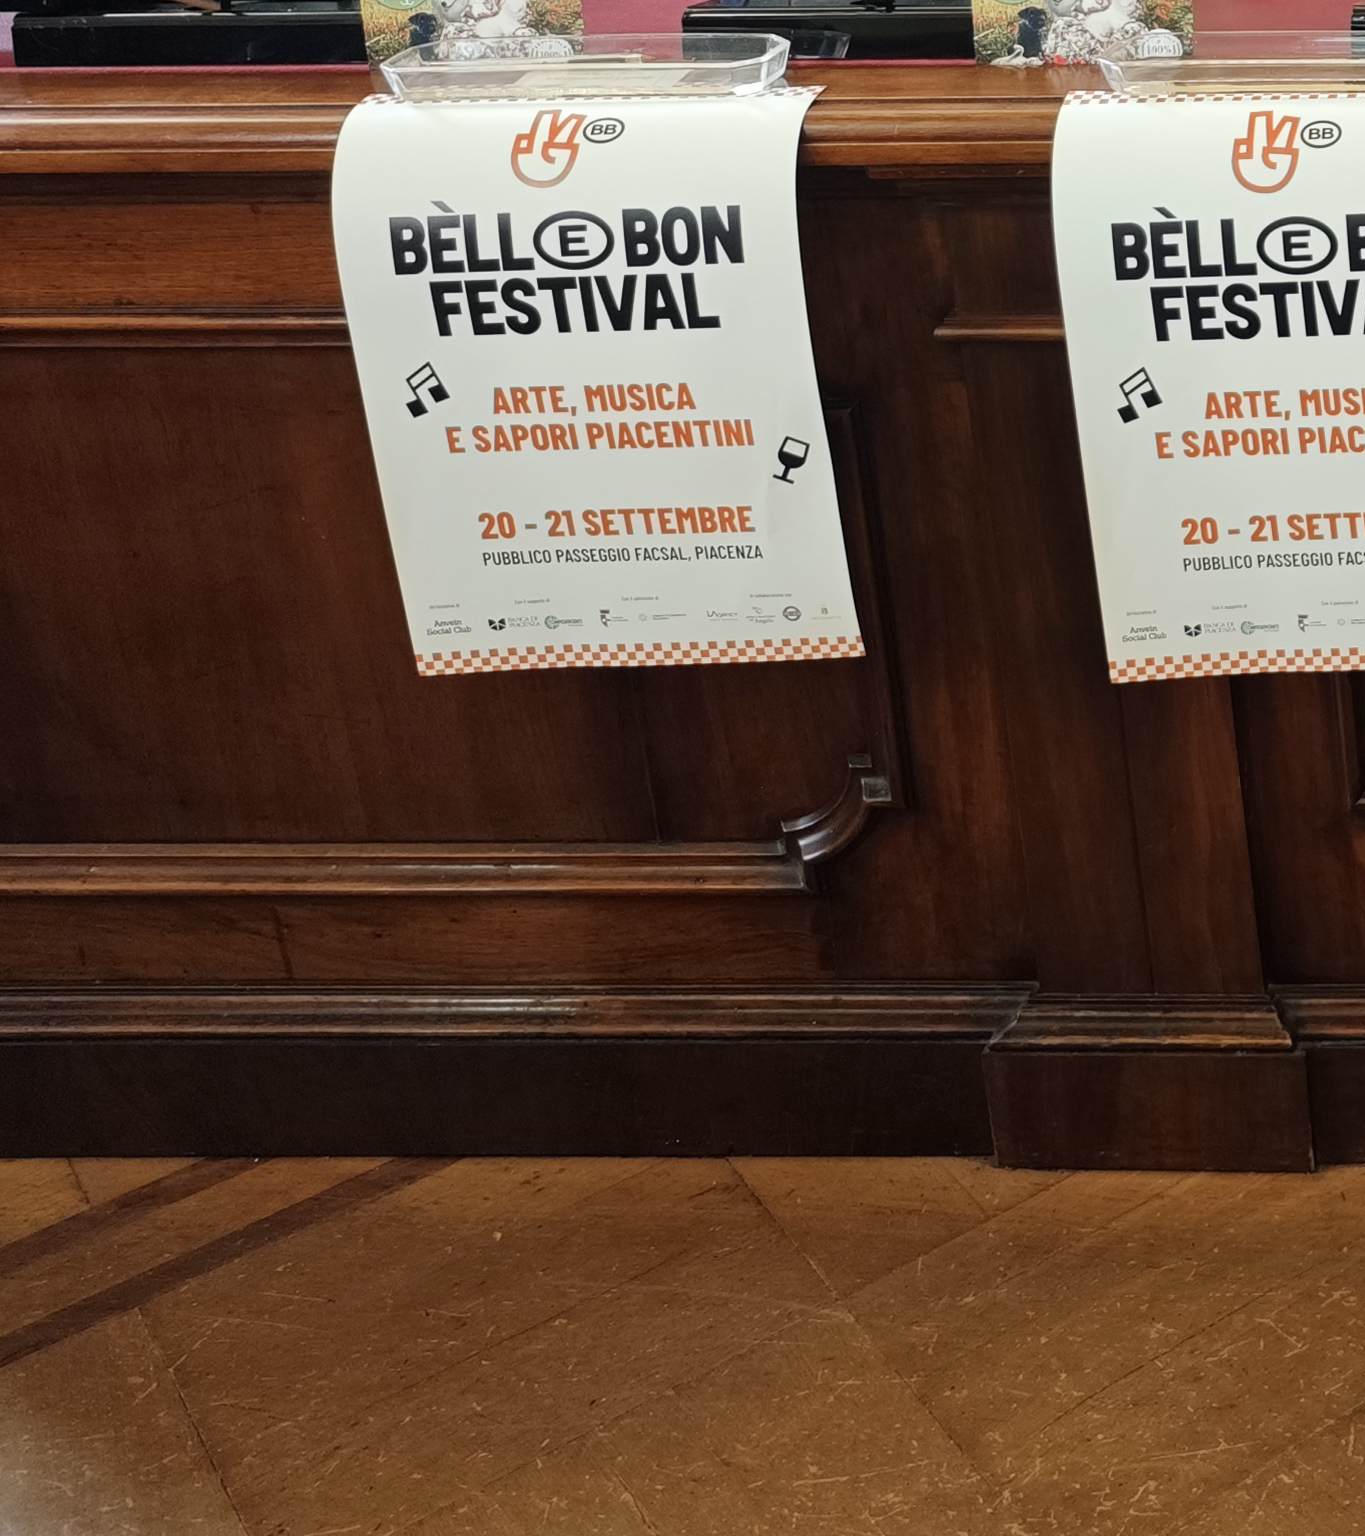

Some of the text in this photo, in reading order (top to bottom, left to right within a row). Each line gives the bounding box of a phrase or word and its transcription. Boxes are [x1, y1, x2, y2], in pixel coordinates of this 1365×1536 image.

[389, 201, 535, 275] BÈLL
[622, 205, 744, 267] BON
[1111, 207, 1258, 281] BÈLL
[429, 273, 721, 337] FESTIVAL
[494, 383, 696, 416] ARTE, MUSICA
[1205, 390, 1290, 421] ARTE,
[446, 419, 754, 453] E SAPORI PIACENTINI
[1155, 432, 1174, 459] E
[1182, 428, 1289, 458] SAPORI
[479, 512, 516, 539] 20
[545, 511, 576, 537] 21
[582, 506, 755, 536] SETTEMBRE
[1181, 517, 1218, 545] 20
[1249, 515, 1279, 542] 21
[482, 545, 763, 566] PUBBLICO PASSEGGIO FACSAL, PIACENZA
[1183, 555, 1252, 572] PUBBLICO
[1257, 552, 1333, 568] PASSEGGIO
